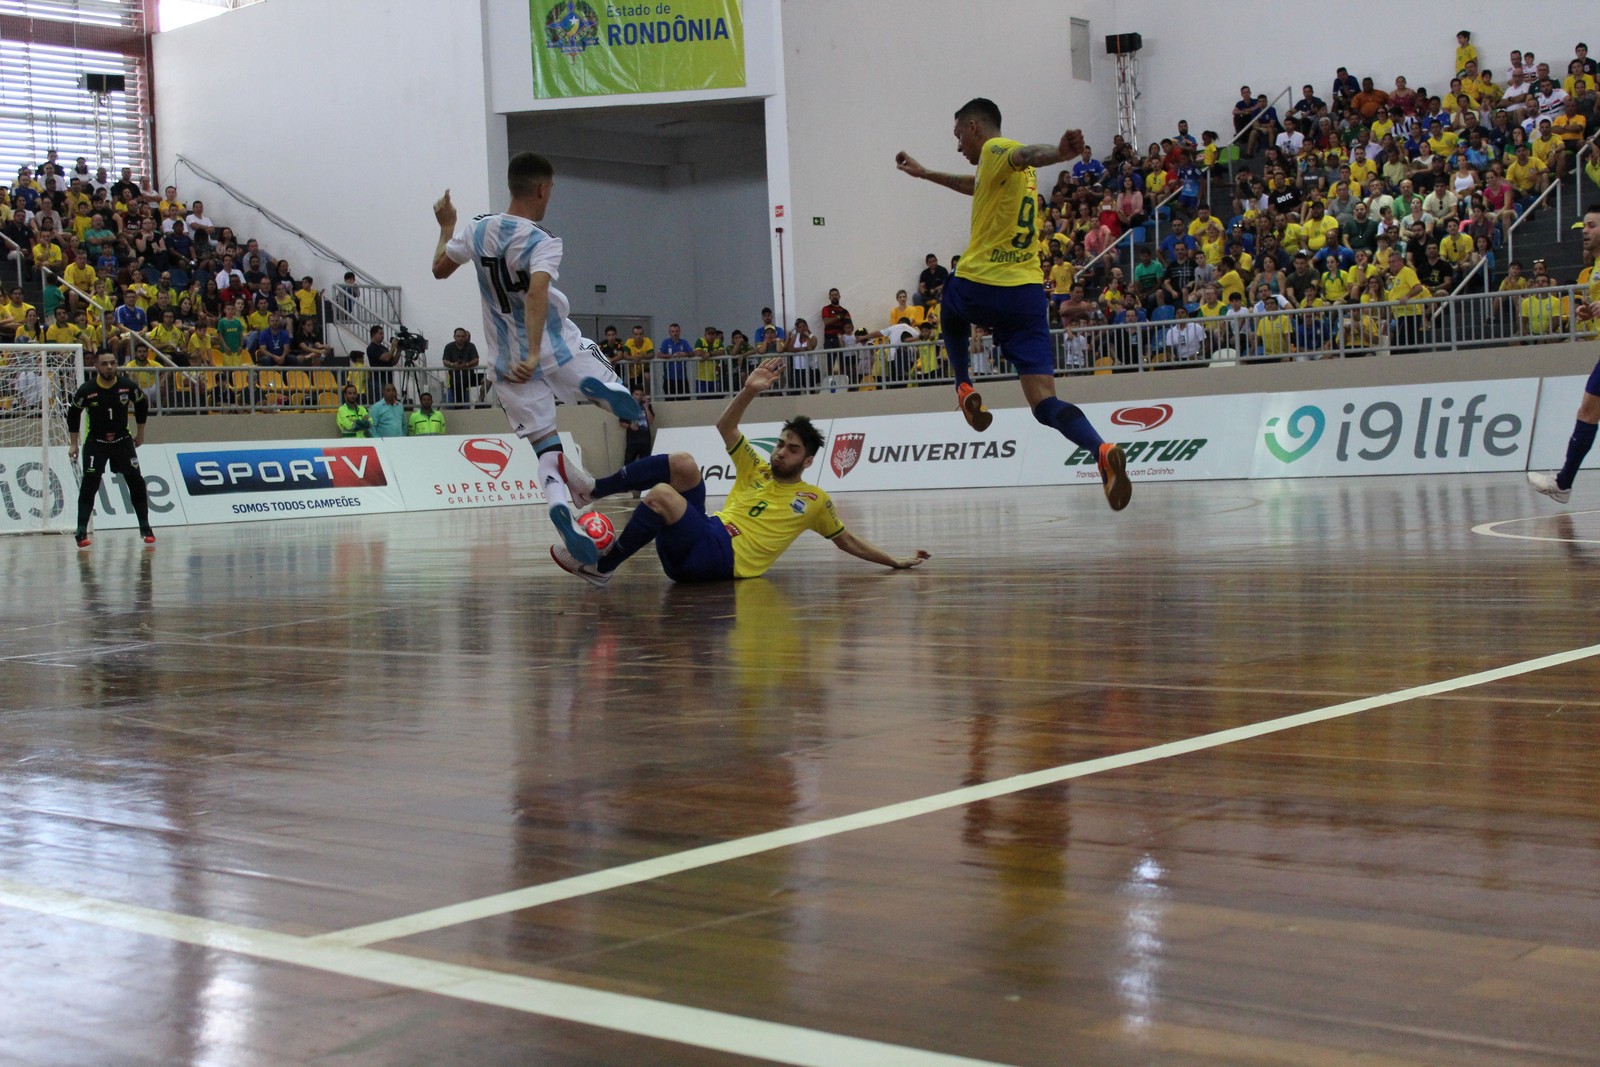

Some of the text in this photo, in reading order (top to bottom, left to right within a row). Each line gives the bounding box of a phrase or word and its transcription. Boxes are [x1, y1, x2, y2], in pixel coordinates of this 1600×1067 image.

[606, 4, 671, 18] Estado de
[607, 15, 730, 47] RONDÔNIA
[1012, 196, 1035, 249] 9
[480, 254, 532, 314] 14
[108, 407, 113, 420] 1
[868, 440, 1017, 463] UNIVERITAS
[1064, 438, 1208, 466] EUATUR
[195, 455, 368, 486] SPORTV
[1147, 467, 1175, 476] Carinho
[433, 479, 538, 495] SUPERGRA
[510, 491, 546, 501] RÁPID
[232, 496, 361, 514] SOMOS TODOS CAMPEÕES
[747, 500, 769, 518] 8
